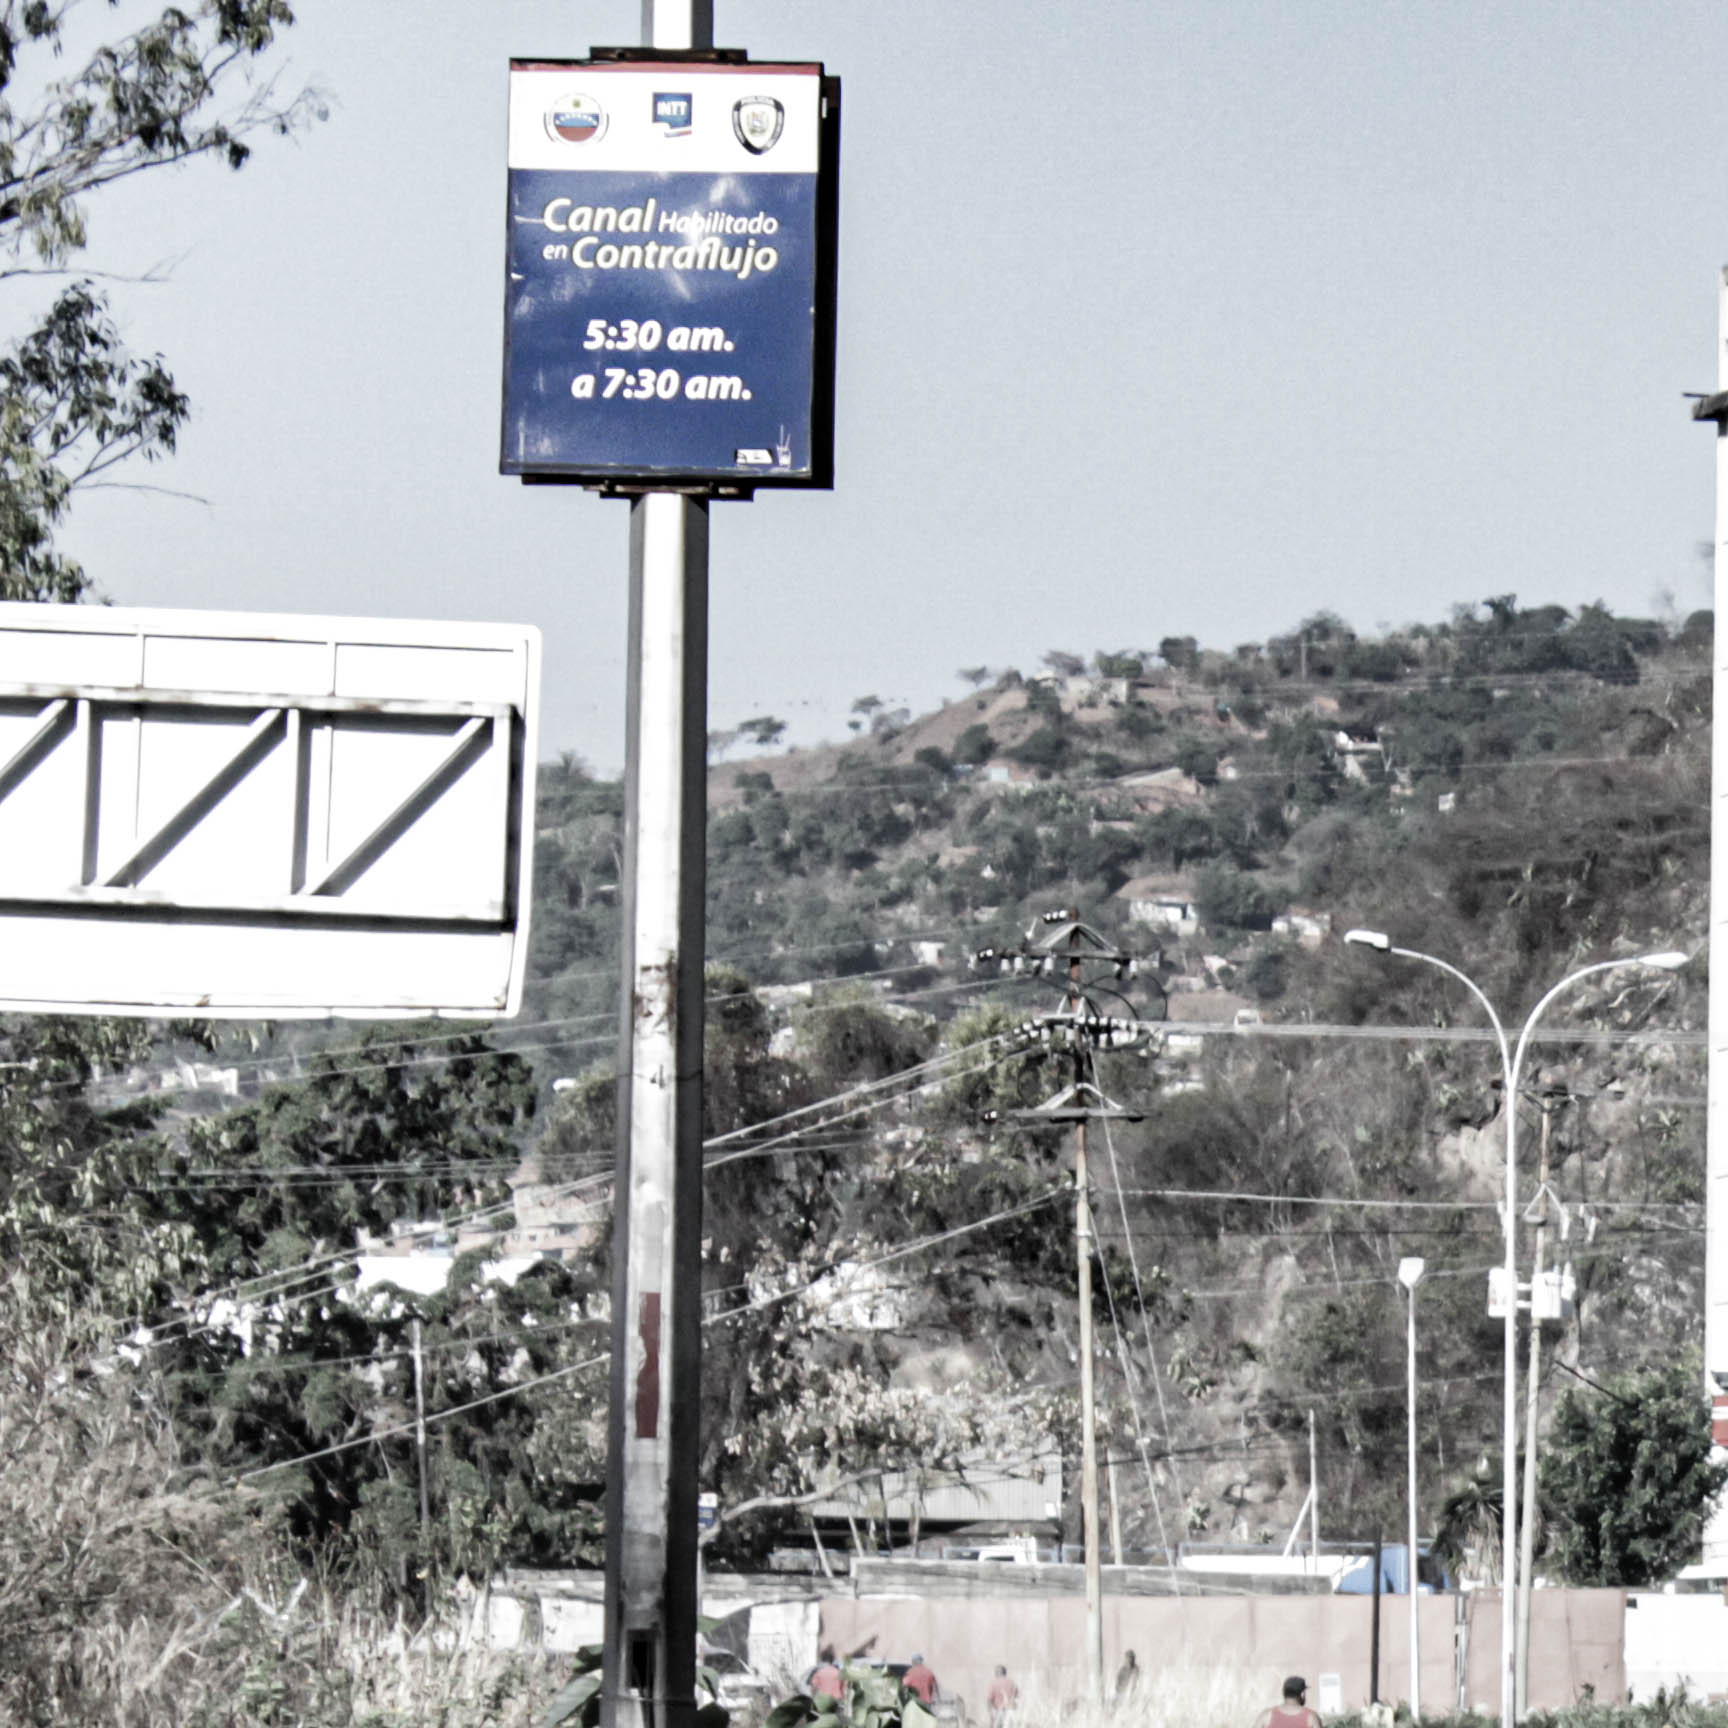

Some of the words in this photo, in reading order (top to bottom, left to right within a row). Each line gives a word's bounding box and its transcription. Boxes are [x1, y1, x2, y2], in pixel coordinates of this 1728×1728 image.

[656, 100, 688, 116] INTT
[543, 197, 657, 233] Canal
[658, 210, 779, 235] Habilitado
[542, 243, 569, 261] en
[572, 236, 779, 280] Contraflujo
[583, 319, 662, 351] 5:30
[666, 326, 735, 352] am.
[571, 373, 596, 399] a
[602, 368, 680, 400] 7:30
[684, 375, 752, 400] am.
